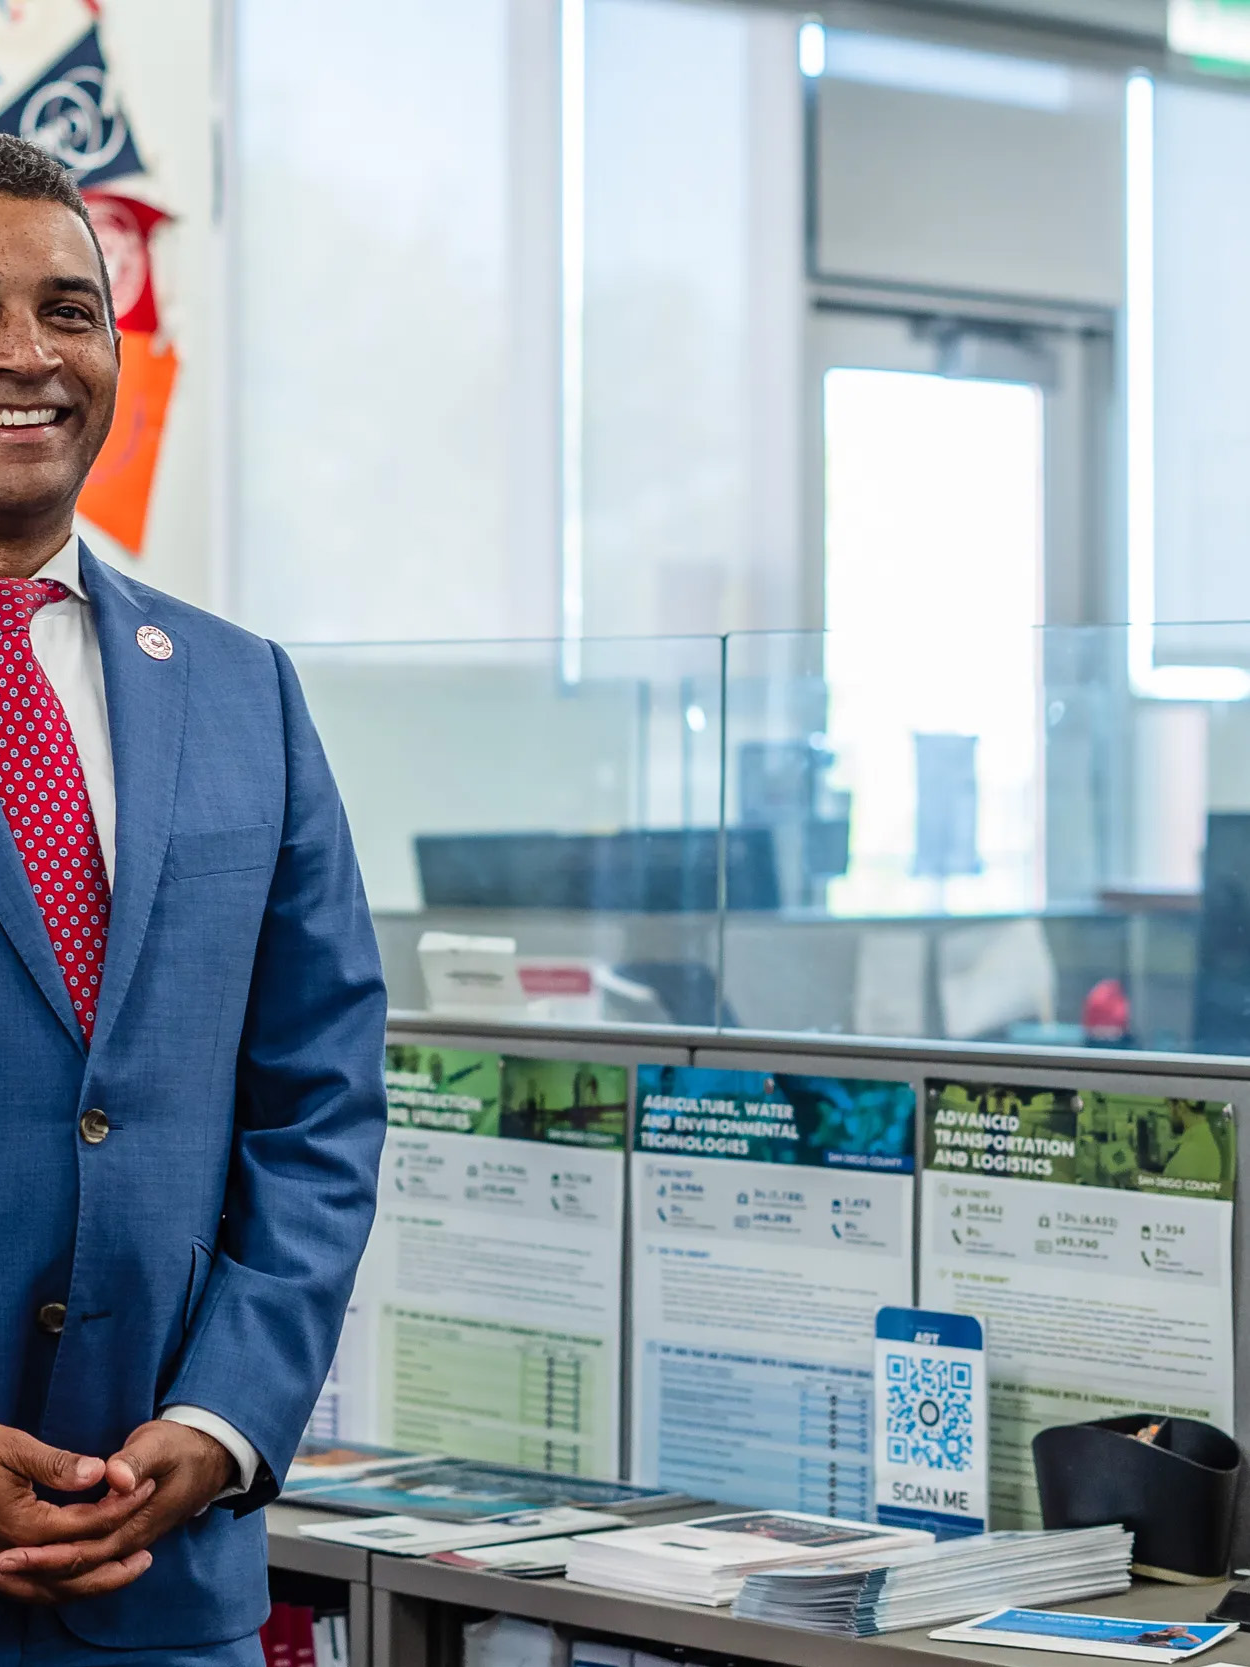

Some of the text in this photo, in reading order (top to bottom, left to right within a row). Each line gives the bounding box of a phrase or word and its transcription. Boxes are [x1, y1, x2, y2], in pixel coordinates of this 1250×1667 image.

[643, 1094, 795, 1120] AGRICULTURE, WATER
[641, 1112, 799, 1140] AND ENVIRONMENTAL
[934, 1109, 1020, 1132] ADVANCED
[640, 1132, 749, 1155] TECHNOLOGIES
[934, 1128, 1075, 1157] TRANSPORTATION
[934, 1149, 1053, 1175] AND LOGISTICS
[892, 1482, 969, 1511] SCAN ME
